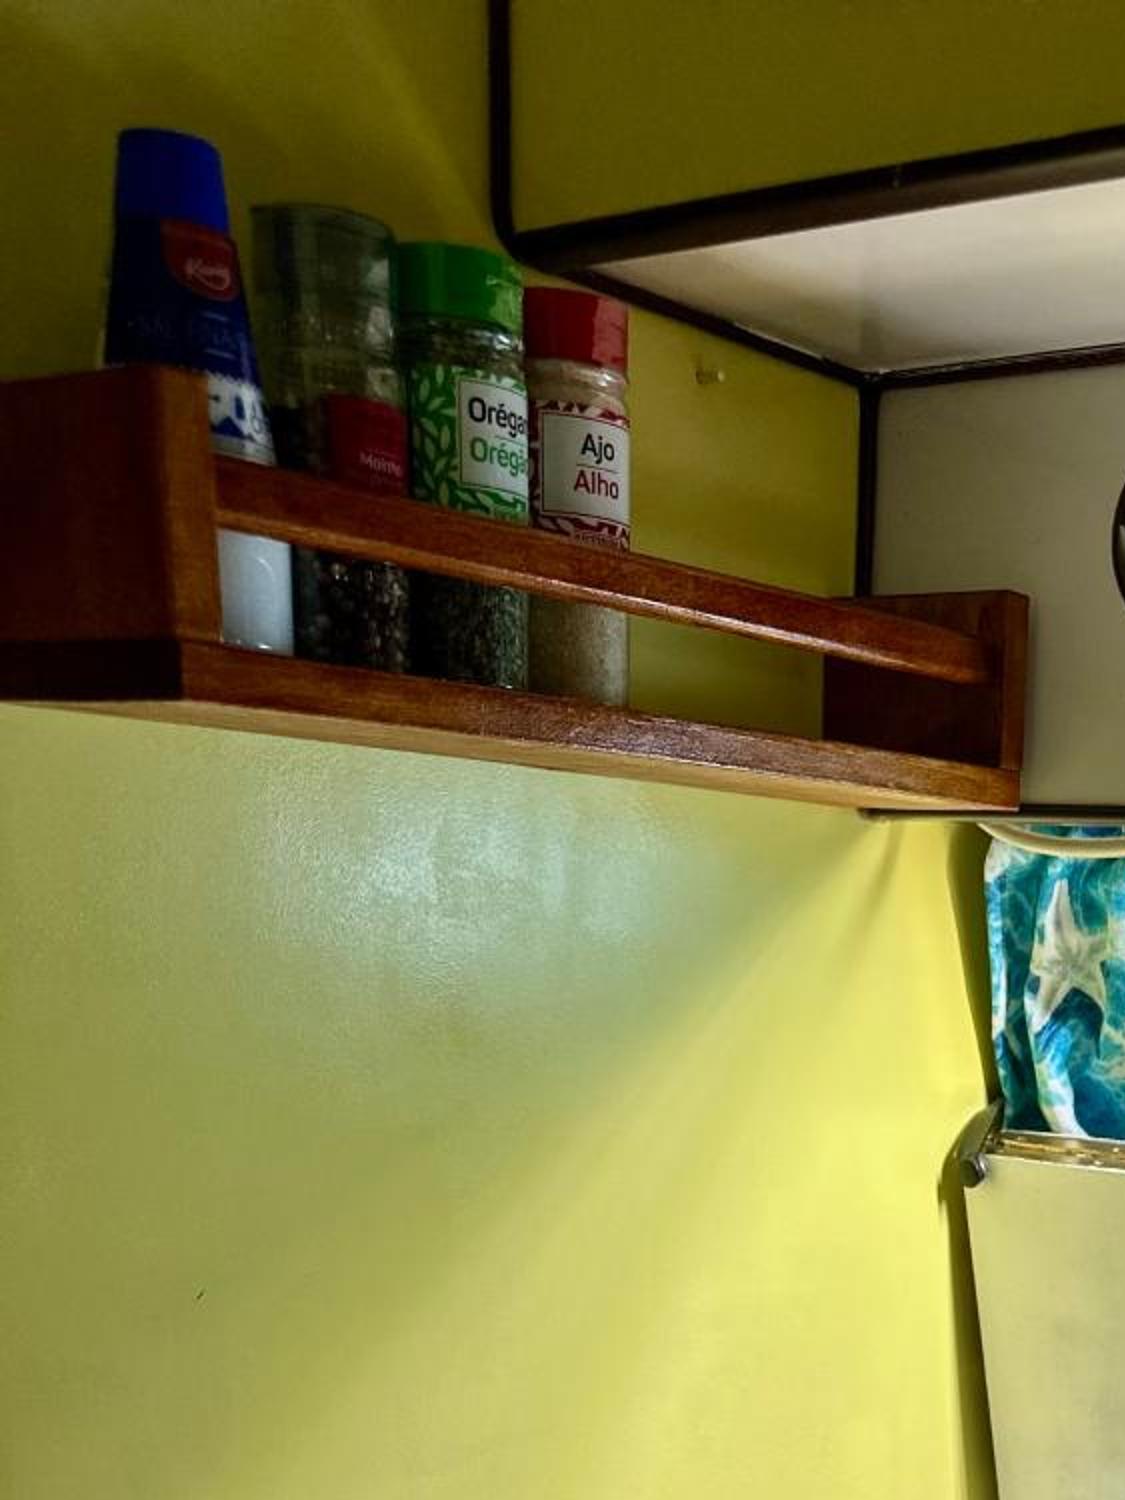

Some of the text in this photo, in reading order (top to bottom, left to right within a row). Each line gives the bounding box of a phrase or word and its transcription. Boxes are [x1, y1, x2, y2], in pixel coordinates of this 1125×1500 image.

[468, 397, 528, 438] Oréga
[470, 437, 528, 477] Orégã
[581, 432, 615, 465] Ajo
[574, 469, 619, 500] Alho
